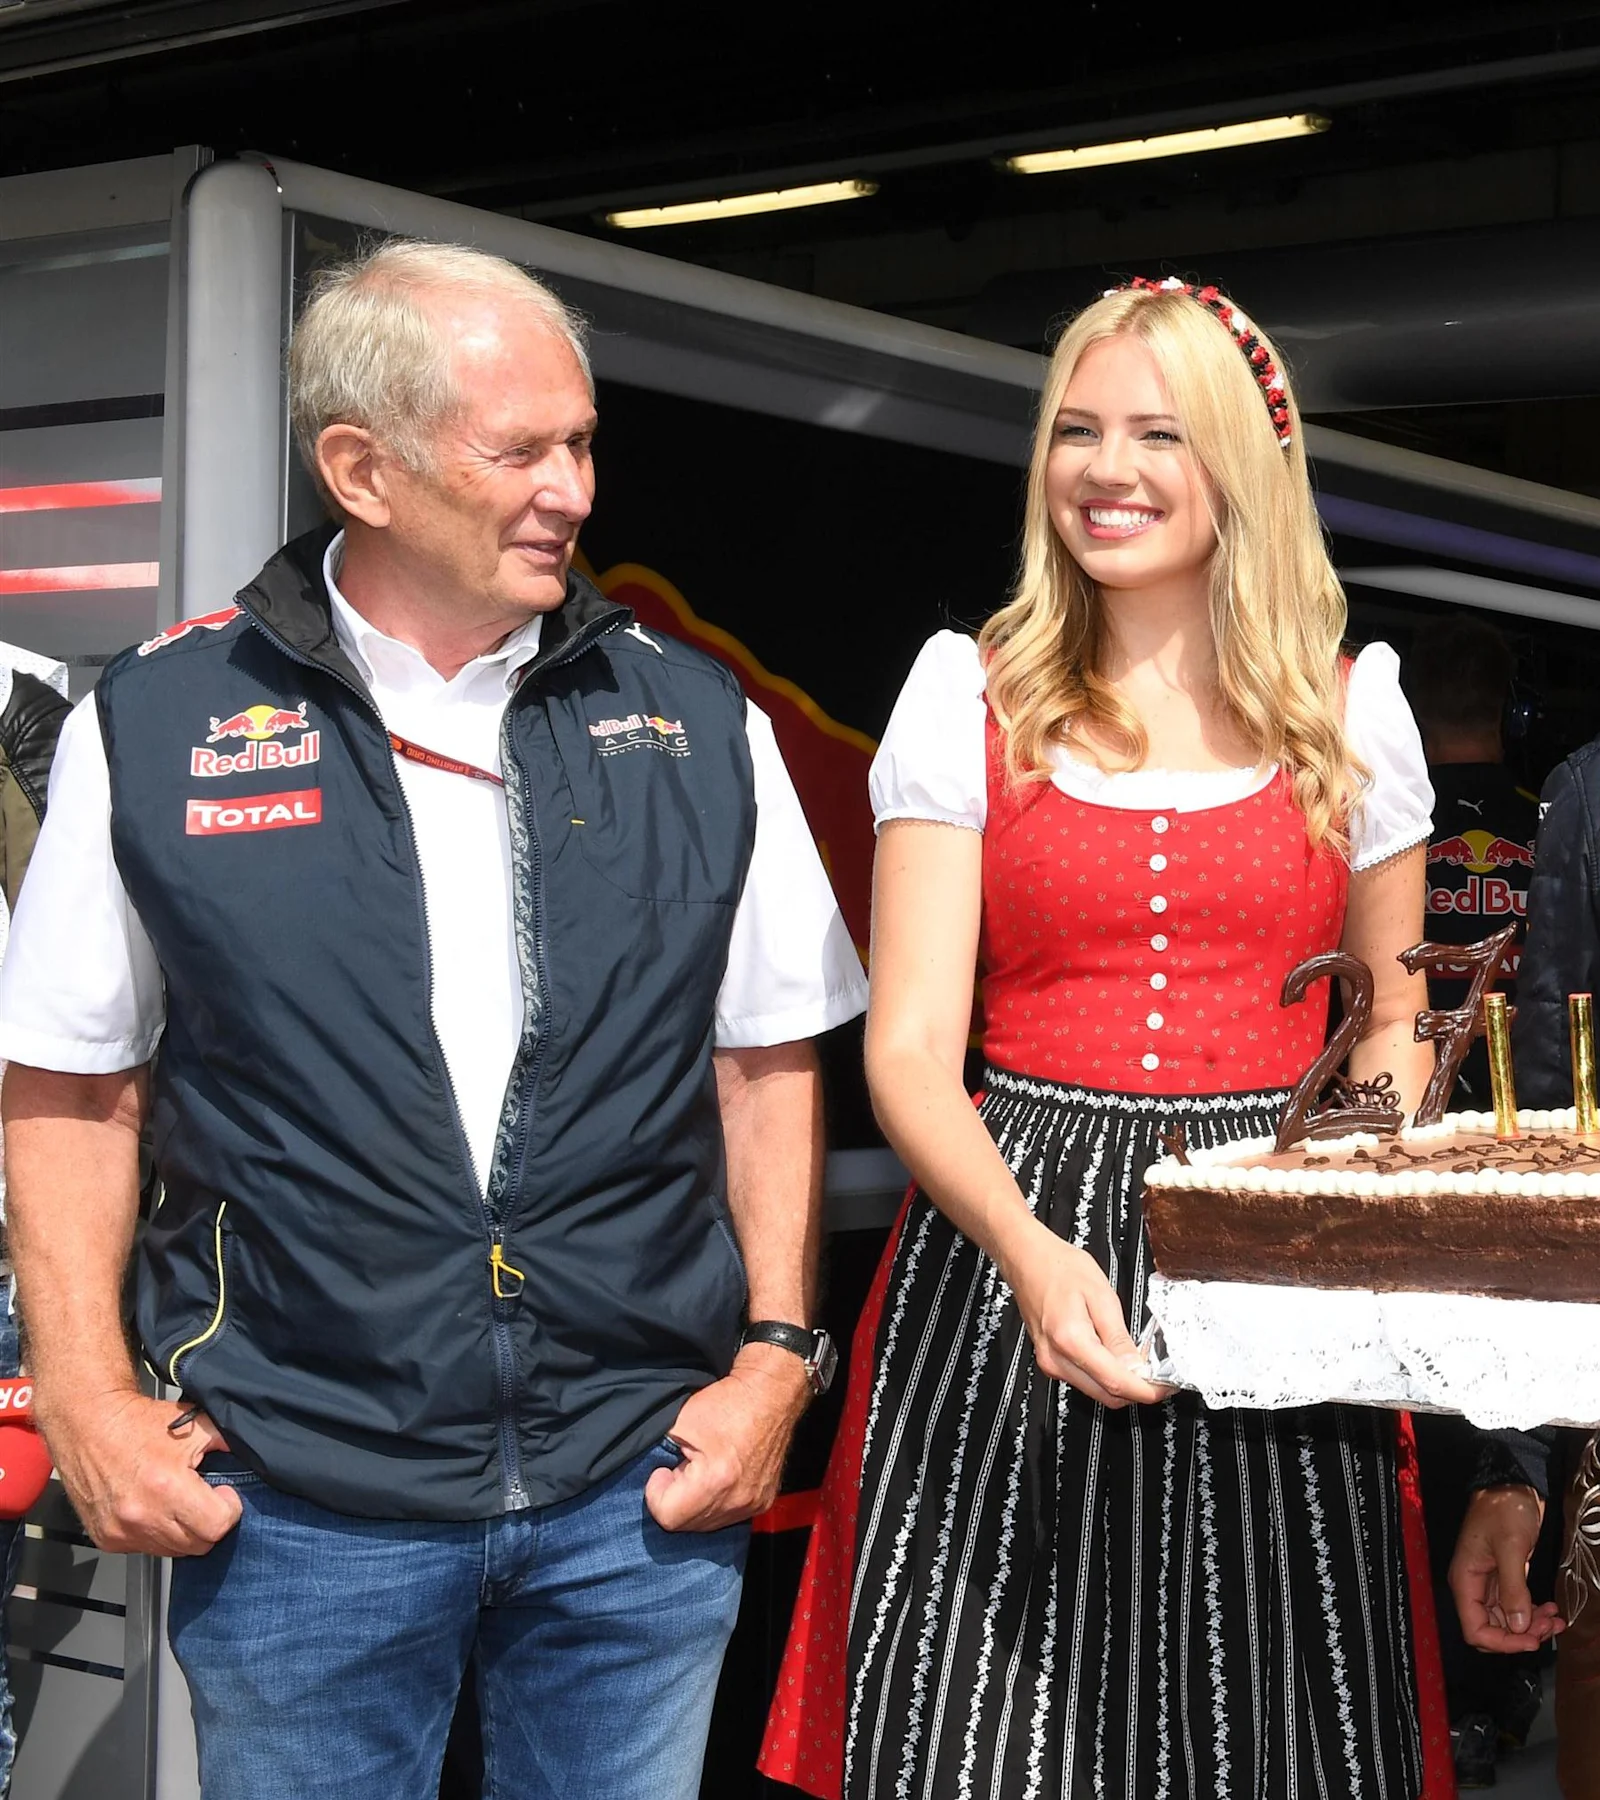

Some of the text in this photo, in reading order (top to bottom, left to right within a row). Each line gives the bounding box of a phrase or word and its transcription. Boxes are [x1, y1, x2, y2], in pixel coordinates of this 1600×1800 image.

[588, 714, 642, 736] ed Bull
[604, 731, 688, 747] ACING
[191, 732, 319, 776] Red Bull
[193, 802, 316, 828] TOTAL
[1483, 879, 1528, 915] Bu
